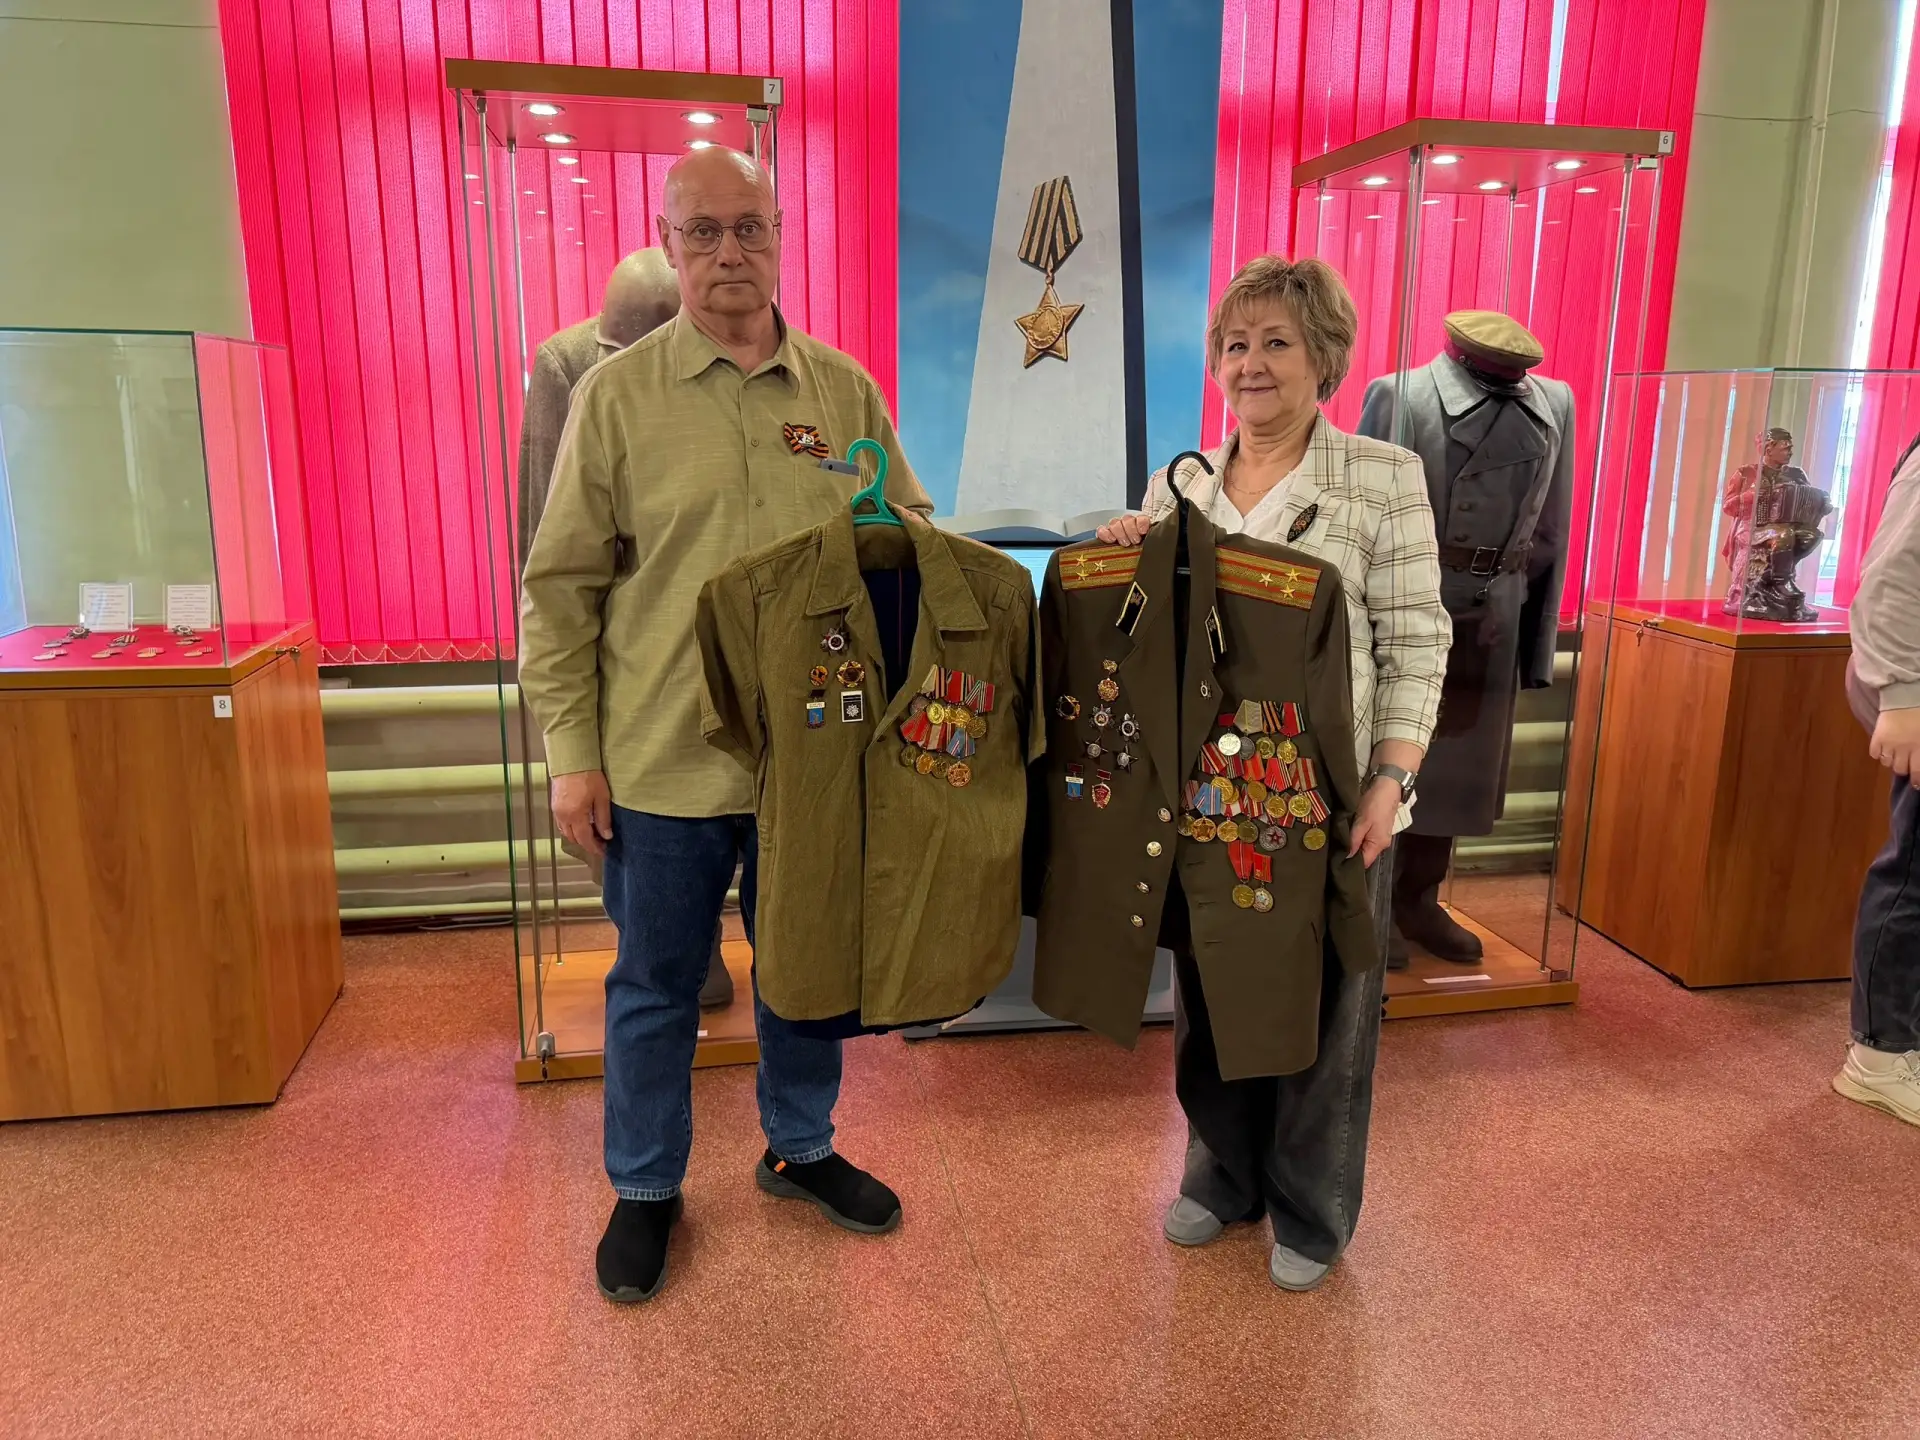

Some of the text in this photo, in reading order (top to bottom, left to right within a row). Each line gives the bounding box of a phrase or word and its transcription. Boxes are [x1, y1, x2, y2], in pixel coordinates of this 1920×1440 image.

[768, 83, 776, 94] 7
[1662, 135, 1669, 145] 6
[218, 699, 227, 710] 8
